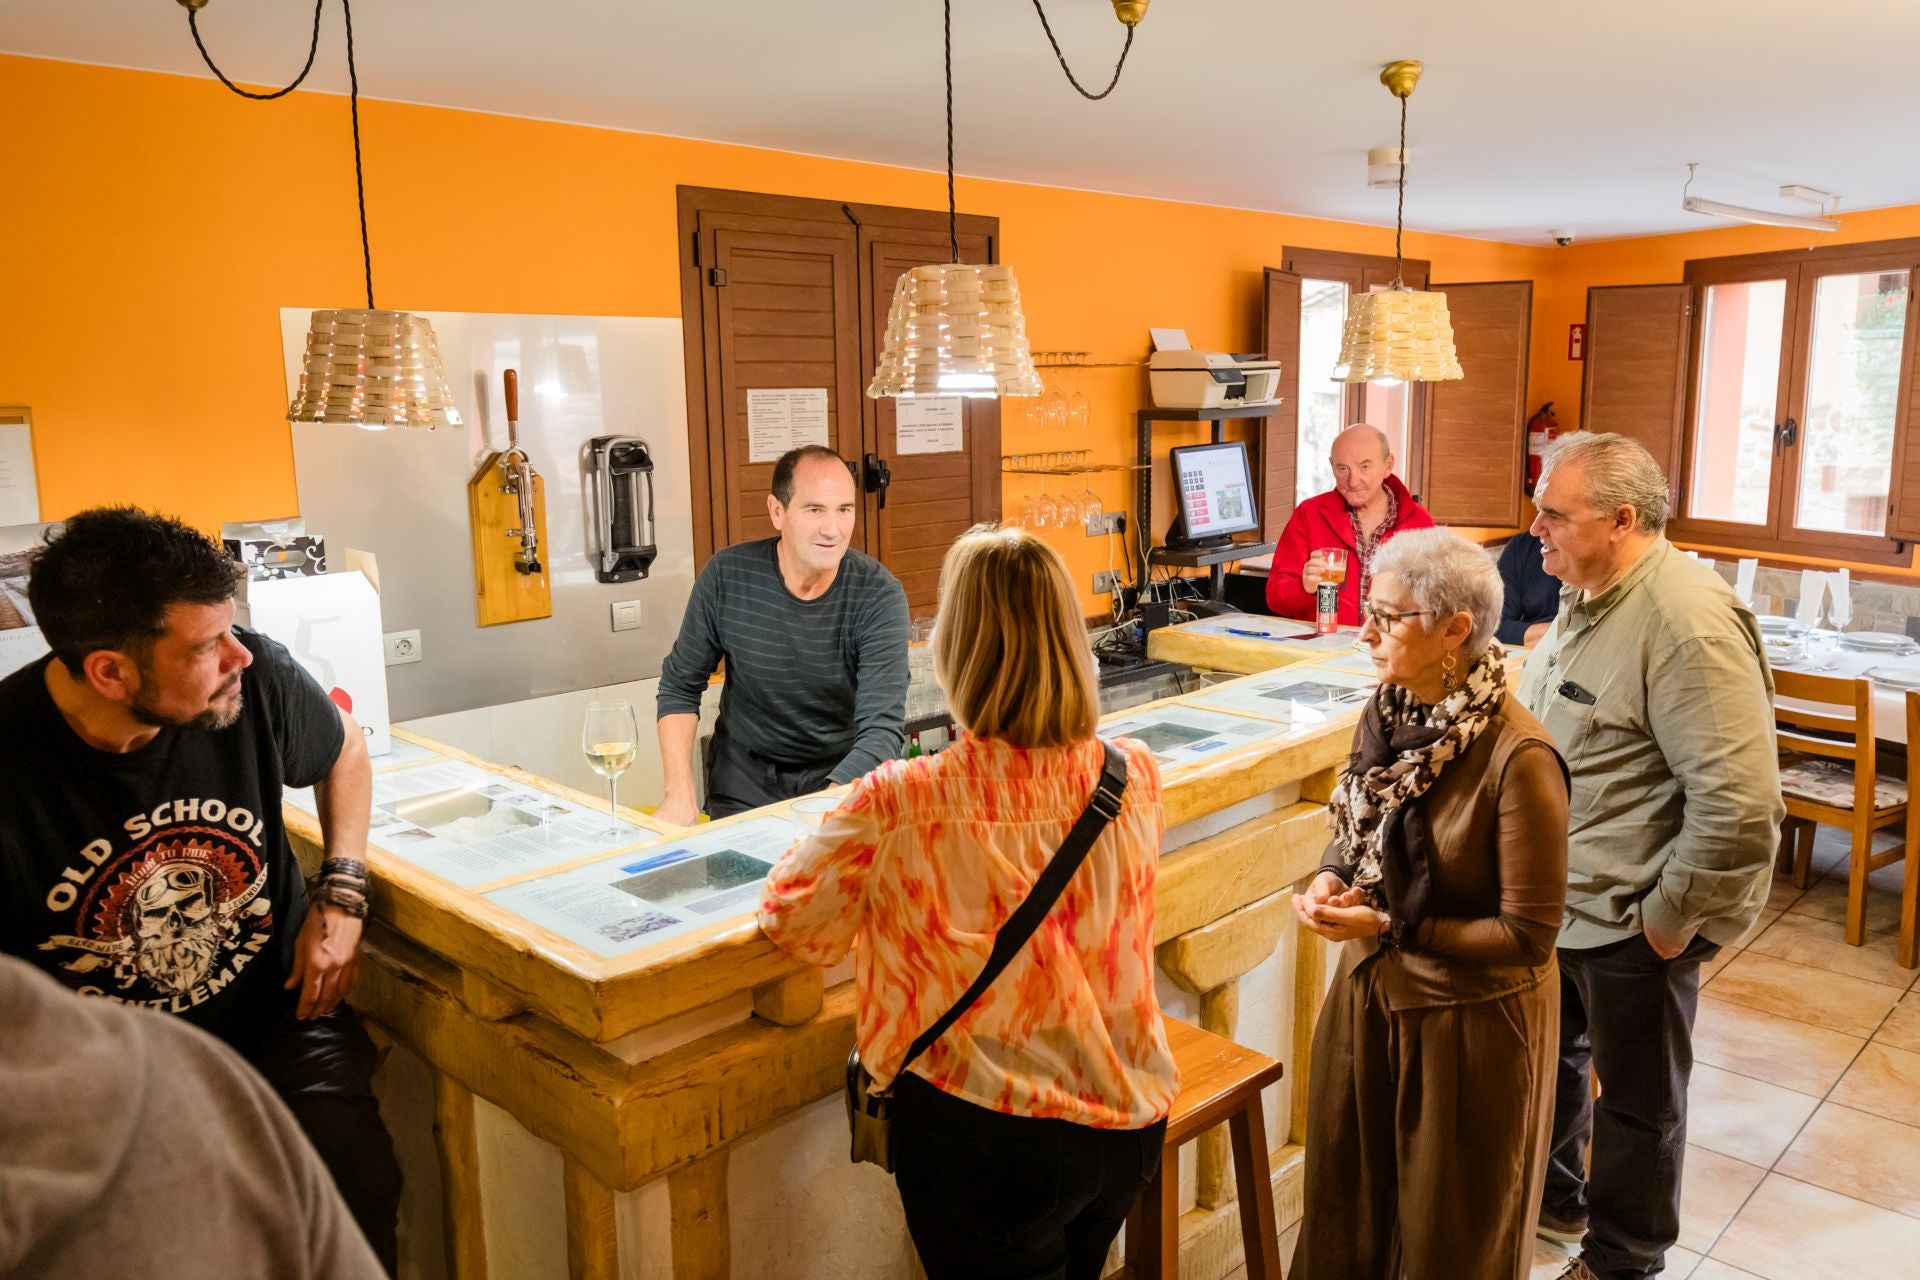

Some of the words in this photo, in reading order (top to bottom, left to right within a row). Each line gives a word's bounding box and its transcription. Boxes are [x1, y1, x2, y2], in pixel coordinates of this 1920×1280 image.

[46, 838, 112, 913] OLD
[123, 798, 264, 847] SCHOOL
[159, 848, 176, 860] TO
[182, 847, 213, 859] RIDE
[66, 938, 95, 949] HAND
[95, 942, 125, 953] MADE
